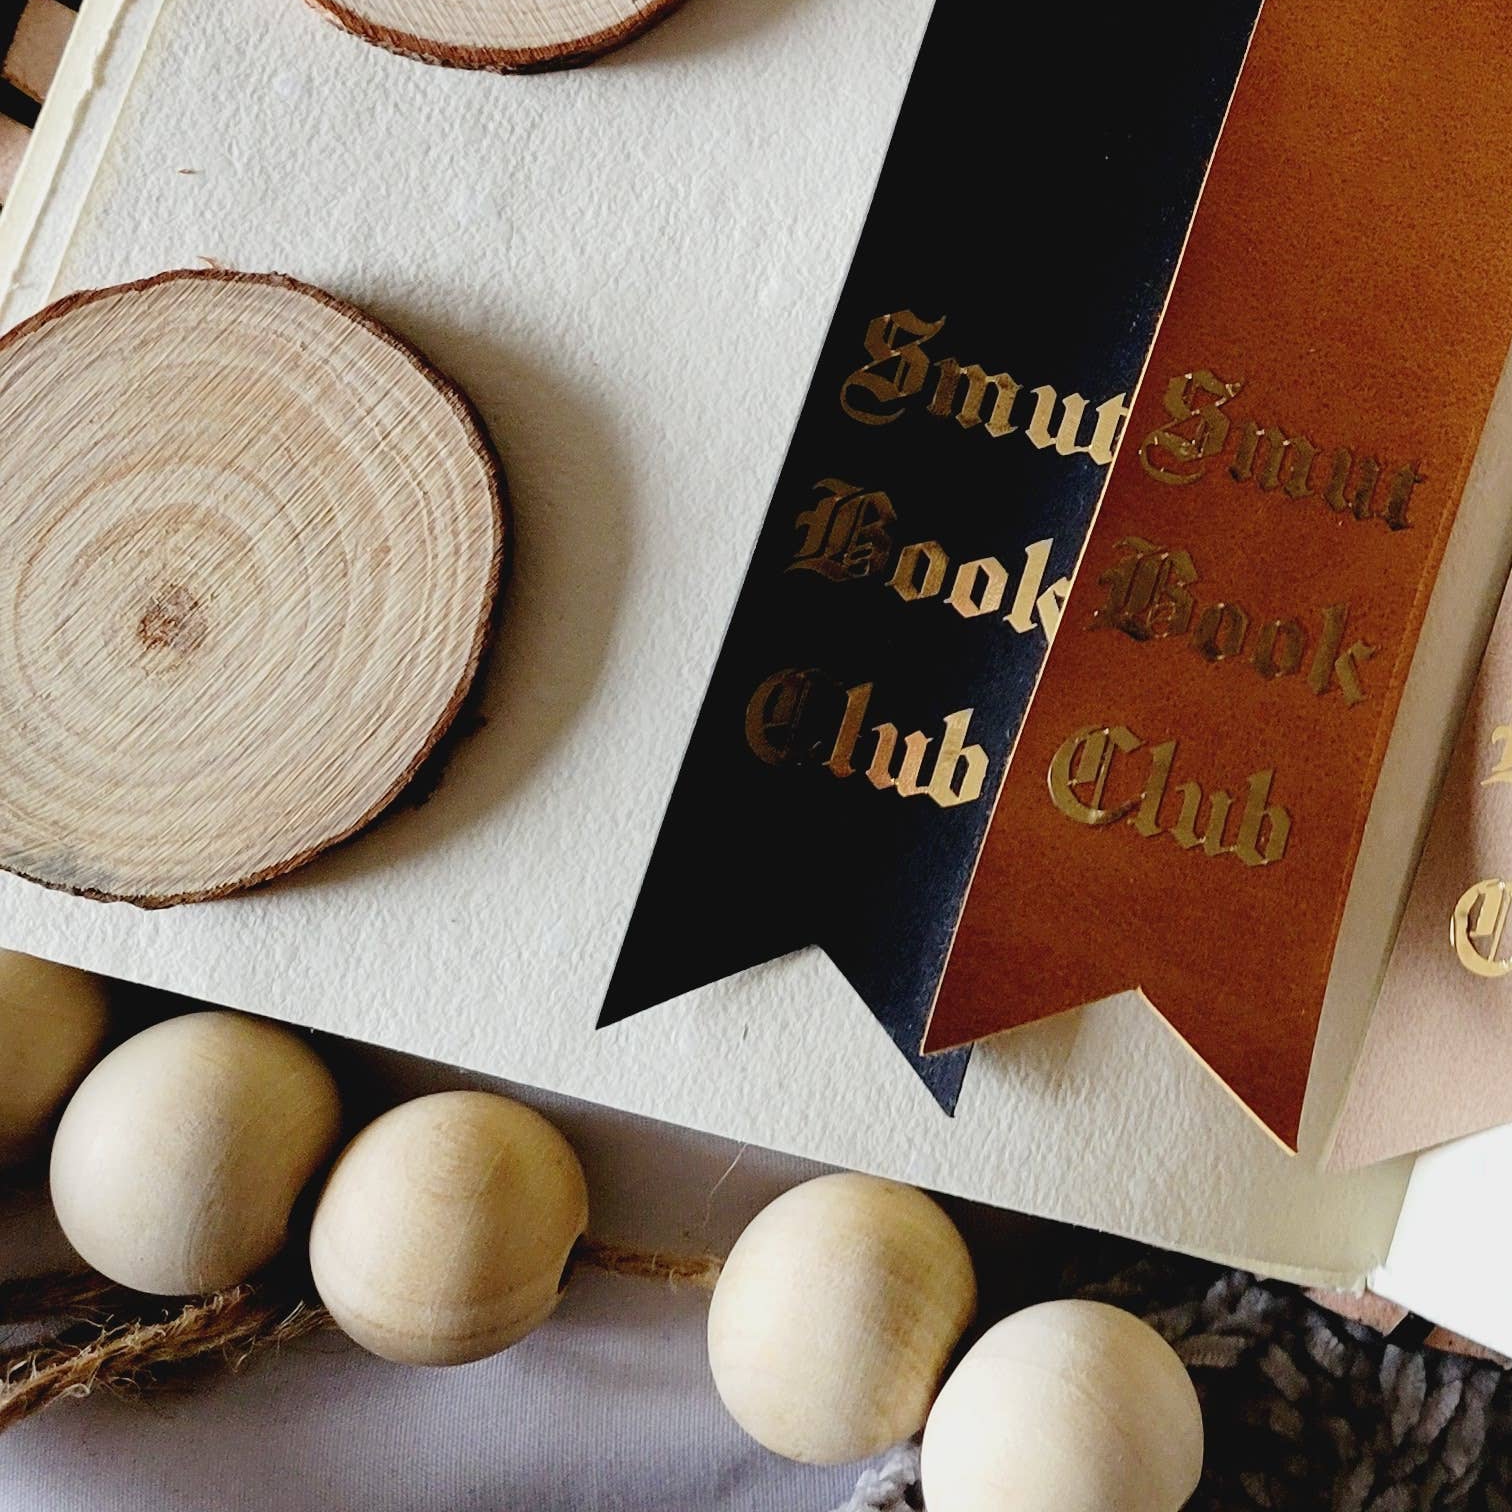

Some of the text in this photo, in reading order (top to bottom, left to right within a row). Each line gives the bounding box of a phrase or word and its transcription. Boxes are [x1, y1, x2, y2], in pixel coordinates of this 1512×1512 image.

[840, 308, 1131, 465] Smut
[1138, 369, 1430, 531] Smut
[787, 476, 1072, 646] Book
[1086, 535, 1379, 708] Book
[744, 666, 991, 809] Club
[1047, 724, 1293, 867] Club
